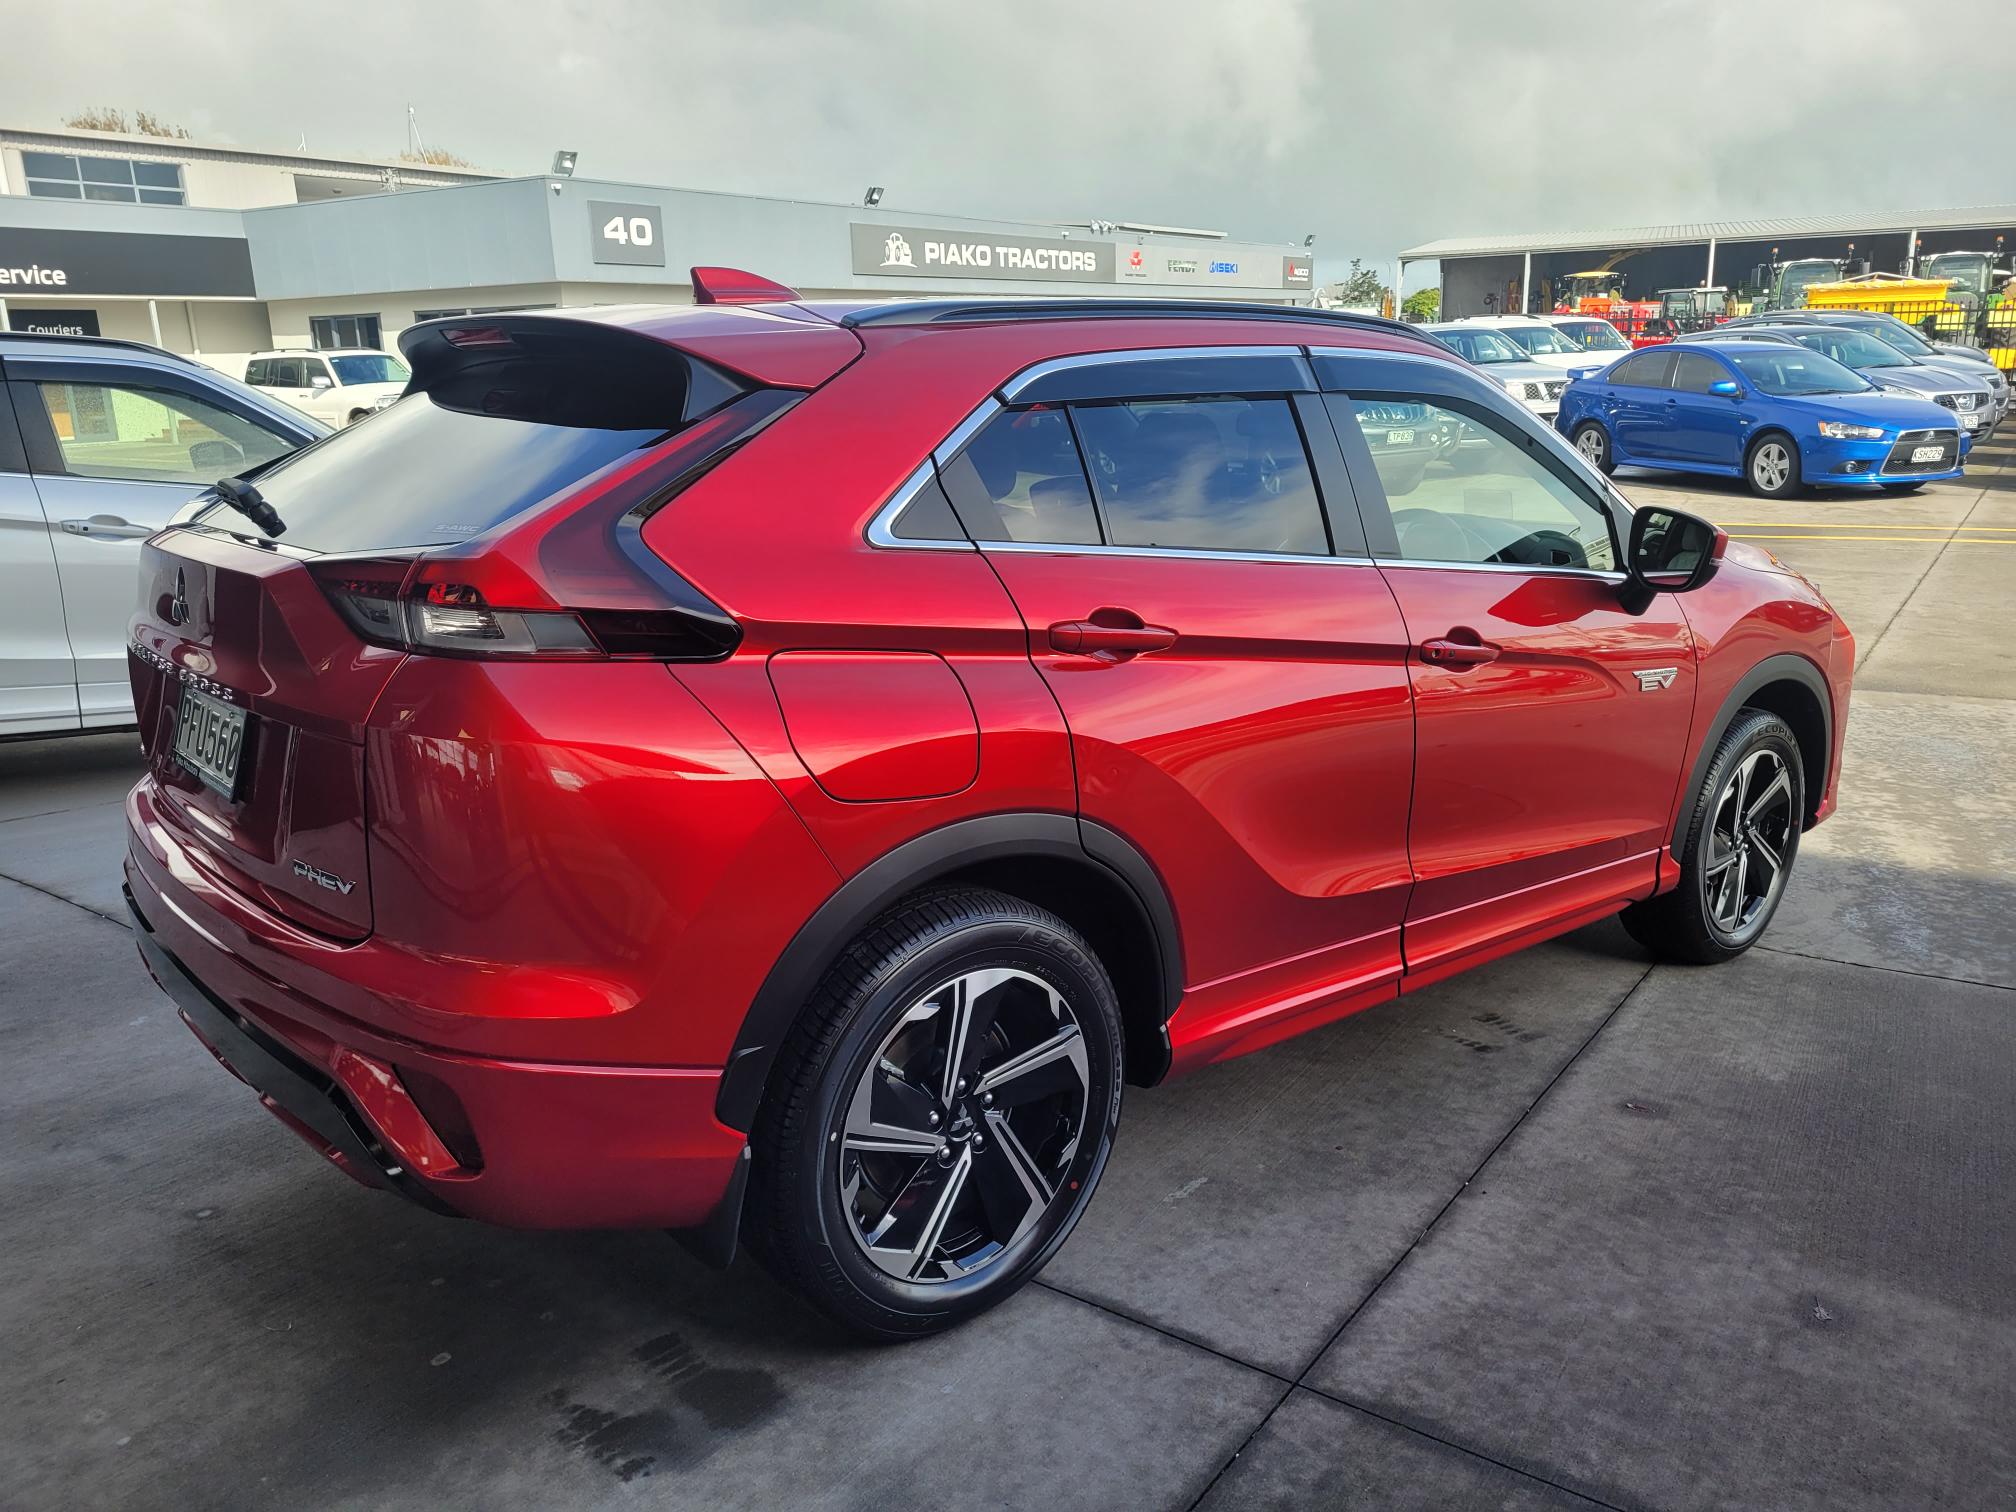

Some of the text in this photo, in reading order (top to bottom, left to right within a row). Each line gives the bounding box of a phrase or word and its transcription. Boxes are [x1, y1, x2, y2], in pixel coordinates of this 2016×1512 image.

[603, 216, 653, 246] 40
[924, 241, 1096, 271] PIAKO TRACTORS
[1216, 263, 1238, 273] ISEKI
[28, 324, 83, 335] Couriers
[1913, 448, 1943, 460] KSH229
[179, 669, 233, 700] CROSS
[1641, 675, 1677, 692] EV
[178, 694, 242, 778] PFU560
[293, 858, 357, 895] PHEV
